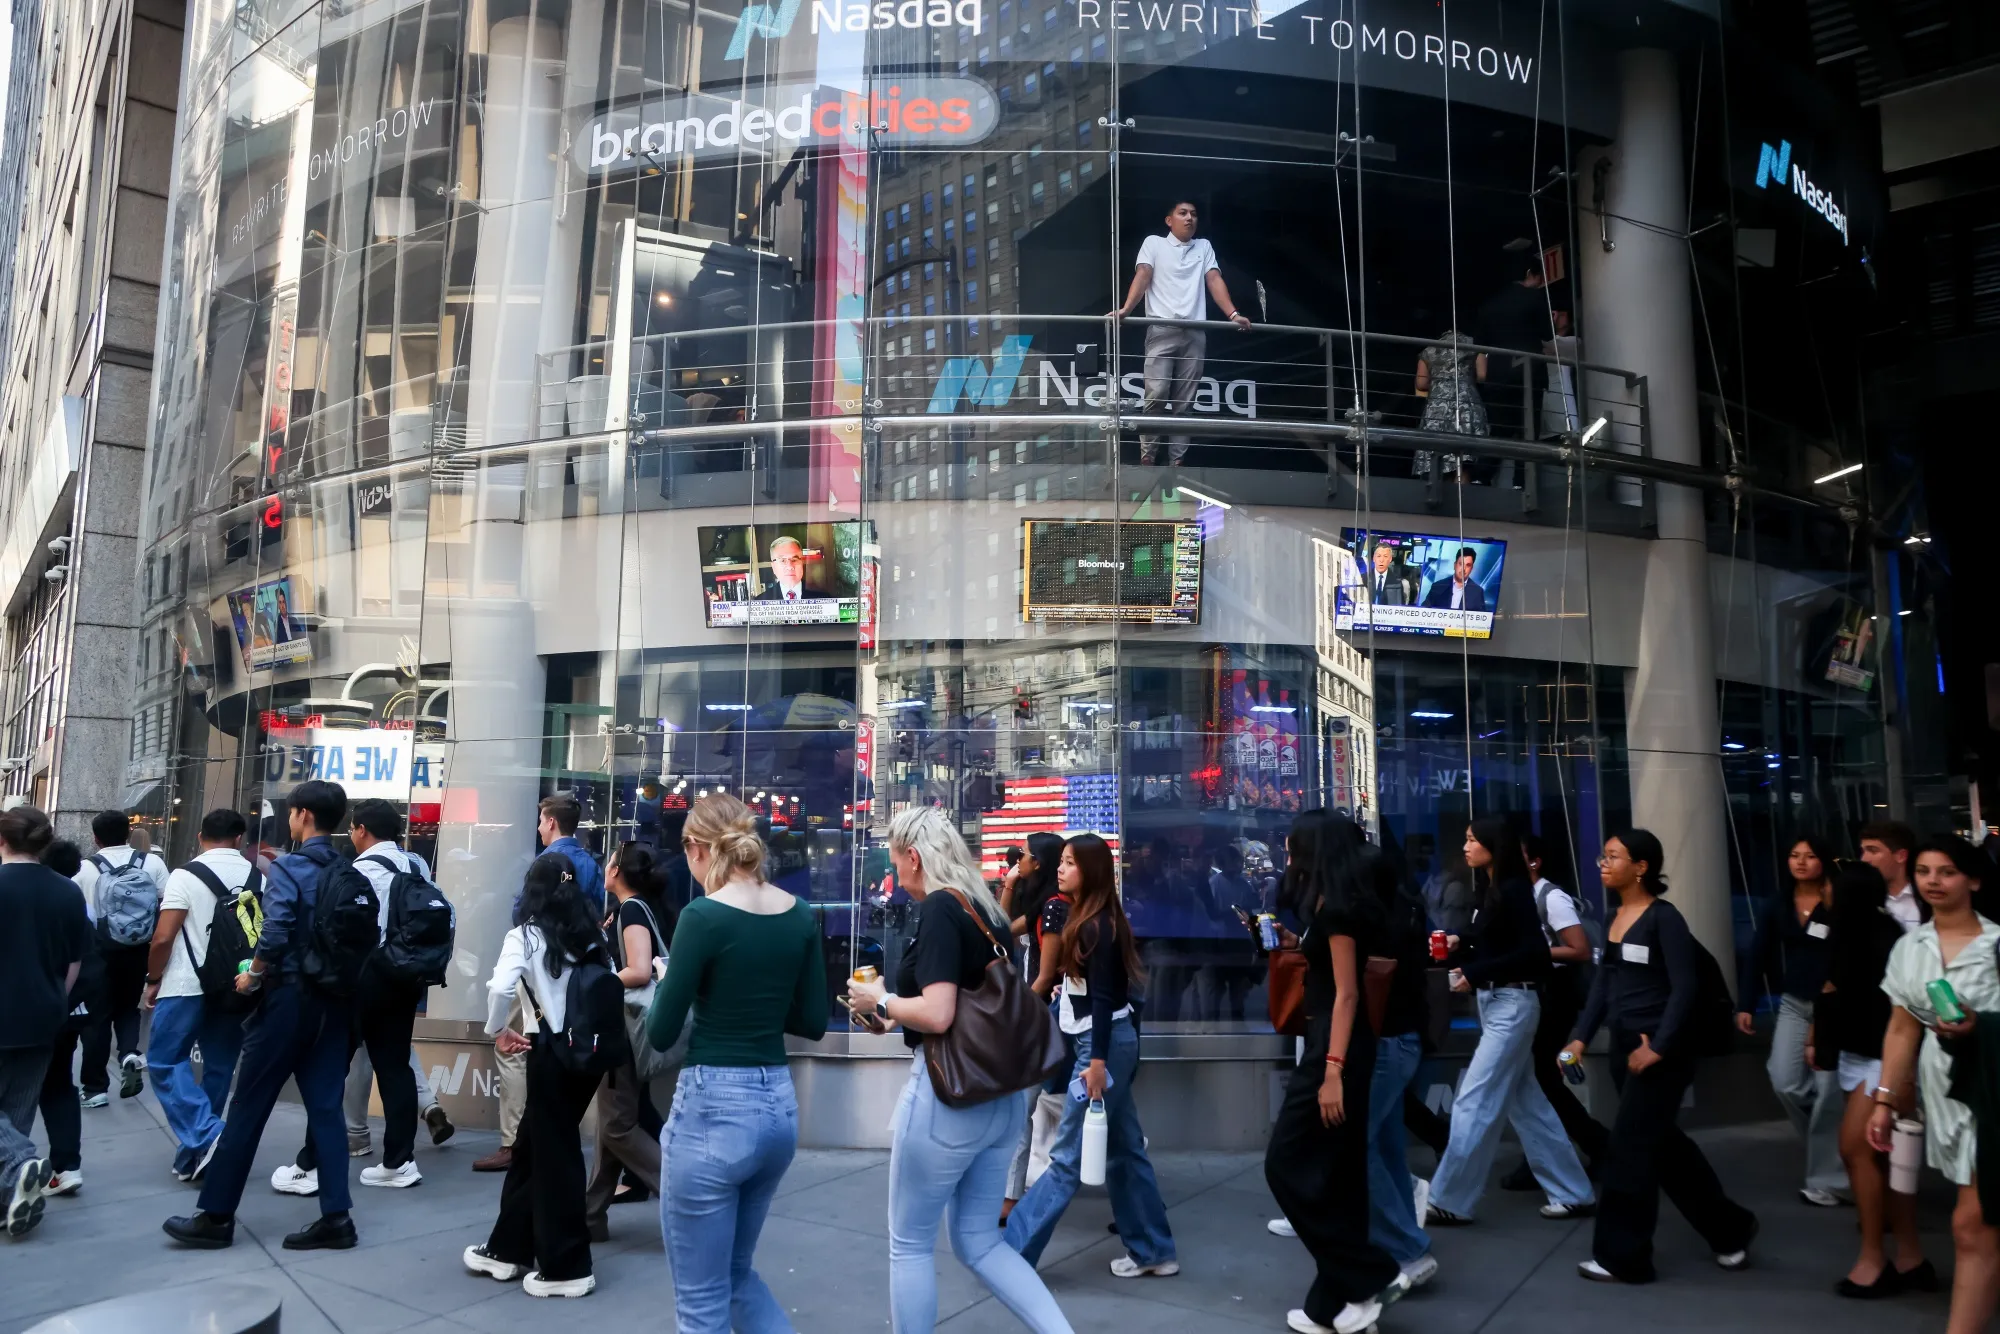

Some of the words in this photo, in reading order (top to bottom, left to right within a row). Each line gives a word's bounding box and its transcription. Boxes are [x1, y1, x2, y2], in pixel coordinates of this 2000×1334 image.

[811, 0, 981, 36] Nasdaq
[1077, 0, 1277, 41] REWRITE
[1302, 14, 1534, 85] TOMORROW
[232, 176, 289, 249] REWRITE
[309, 97, 434, 182] OMORROW
[1793, 163, 1849, 247] Nasdaq
[1039, 360, 1257, 419] Nasaq
[1078, 559, 1125, 571] Bloomberg
[1394, 610, 1420, 618] PRICED
[1421, 611, 1437, 619] OUT
[1449, 613, 1474, 621] GIANTS
[1475, 614, 1488, 622] BID
